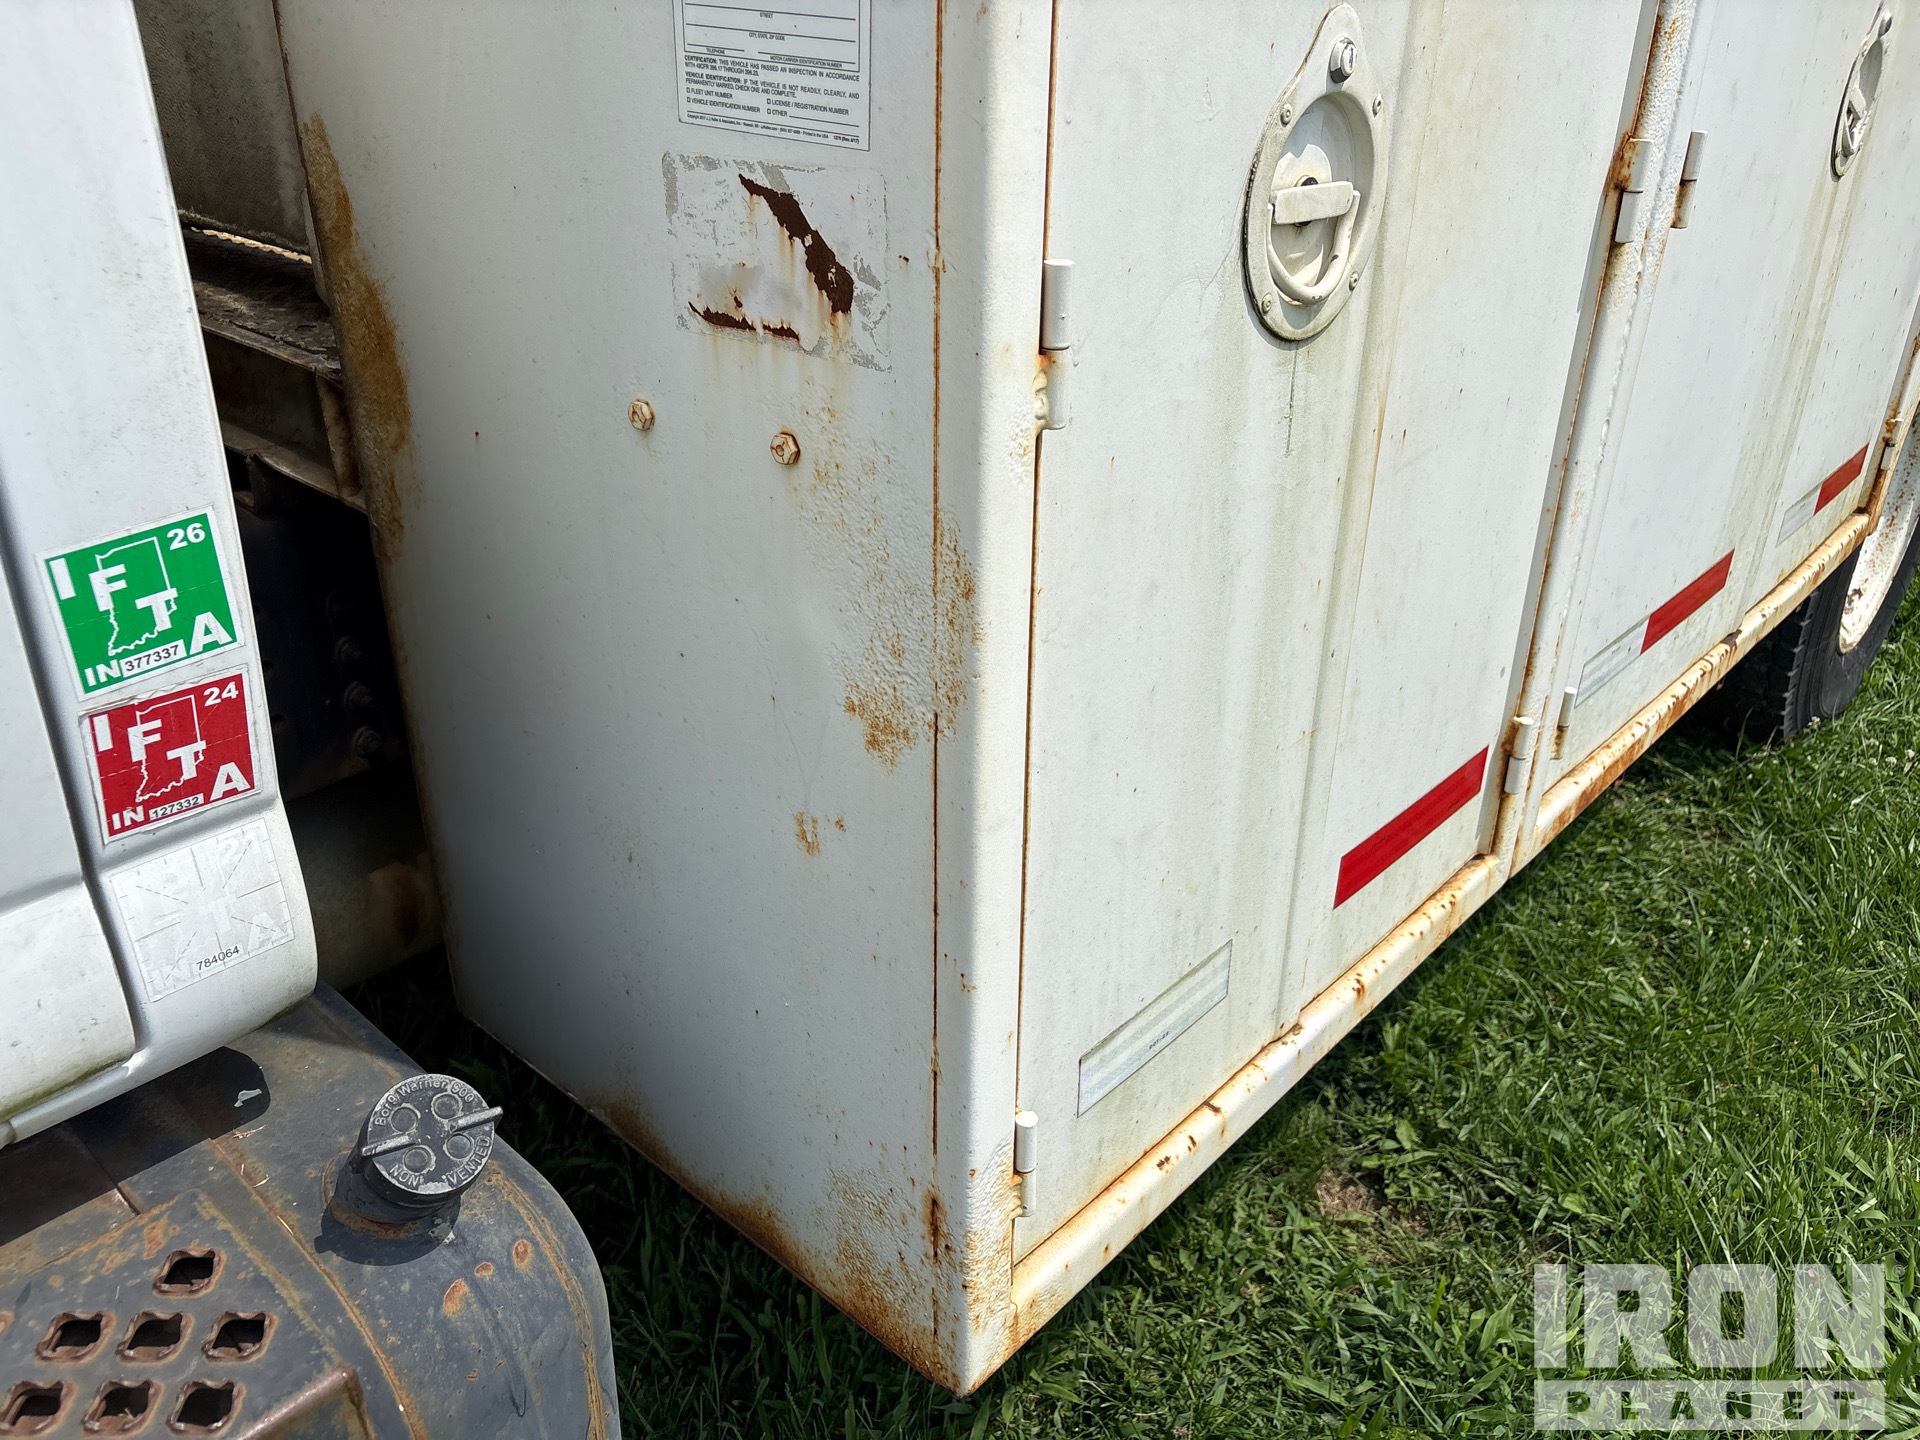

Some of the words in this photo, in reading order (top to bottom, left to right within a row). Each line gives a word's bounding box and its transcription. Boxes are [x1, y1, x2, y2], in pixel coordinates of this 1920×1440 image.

[706, 47, 725, 55] TELEPHONE
[799, 58, 825, 66] IDENTIFICATION
[684, 55, 717, 64] CERTIFICATION:
[730, 60, 748, 68] VEHICLE
[761, 64, 779, 72] PASSED
[789, 68, 817, 77] INSPECTION
[826, 72, 860, 82] ACCORDANCE
[723, 66, 744, 74] THROUGH
[685, 71, 704, 79] VEHICLE
[705, 74, 742, 83] IDENTIFICATION:
[760, 80, 780, 89] VEHICLE
[800, 85, 822, 95] READILY,
[823, 89, 847, 98] CLEARLY,
[686, 78, 715, 87] PERMANENTLY
[716, 81, 734, 89] MARKED,
[735, 84, 750, 92] CHECK
[771, 89, 797, 98] COMPLETE.
[691, 87, 704, 95] FLEET
[715, 91, 733, 99] NUMBER
[709, 100, 741, 110] IDENTIFICATION
[742, 104, 761, 113] NUMBER
[772, 99, 790, 107] LICENSE
[794, 102, 827, 112] REGISTRATION
[829, 106, 849, 115] NUMBER
[167, 522, 206, 551] 26
[85, 659, 121, 686] IN
[124, 643, 180, 672] 377337
[203, 681, 239, 707] 24
[112, 805, 144, 830] IN
[151, 796, 200, 819] 127332
[195, 945, 240, 971] 784064
[451, 1081, 475, 1103] 900
[447, 1135, 491, 1186] VENTED
